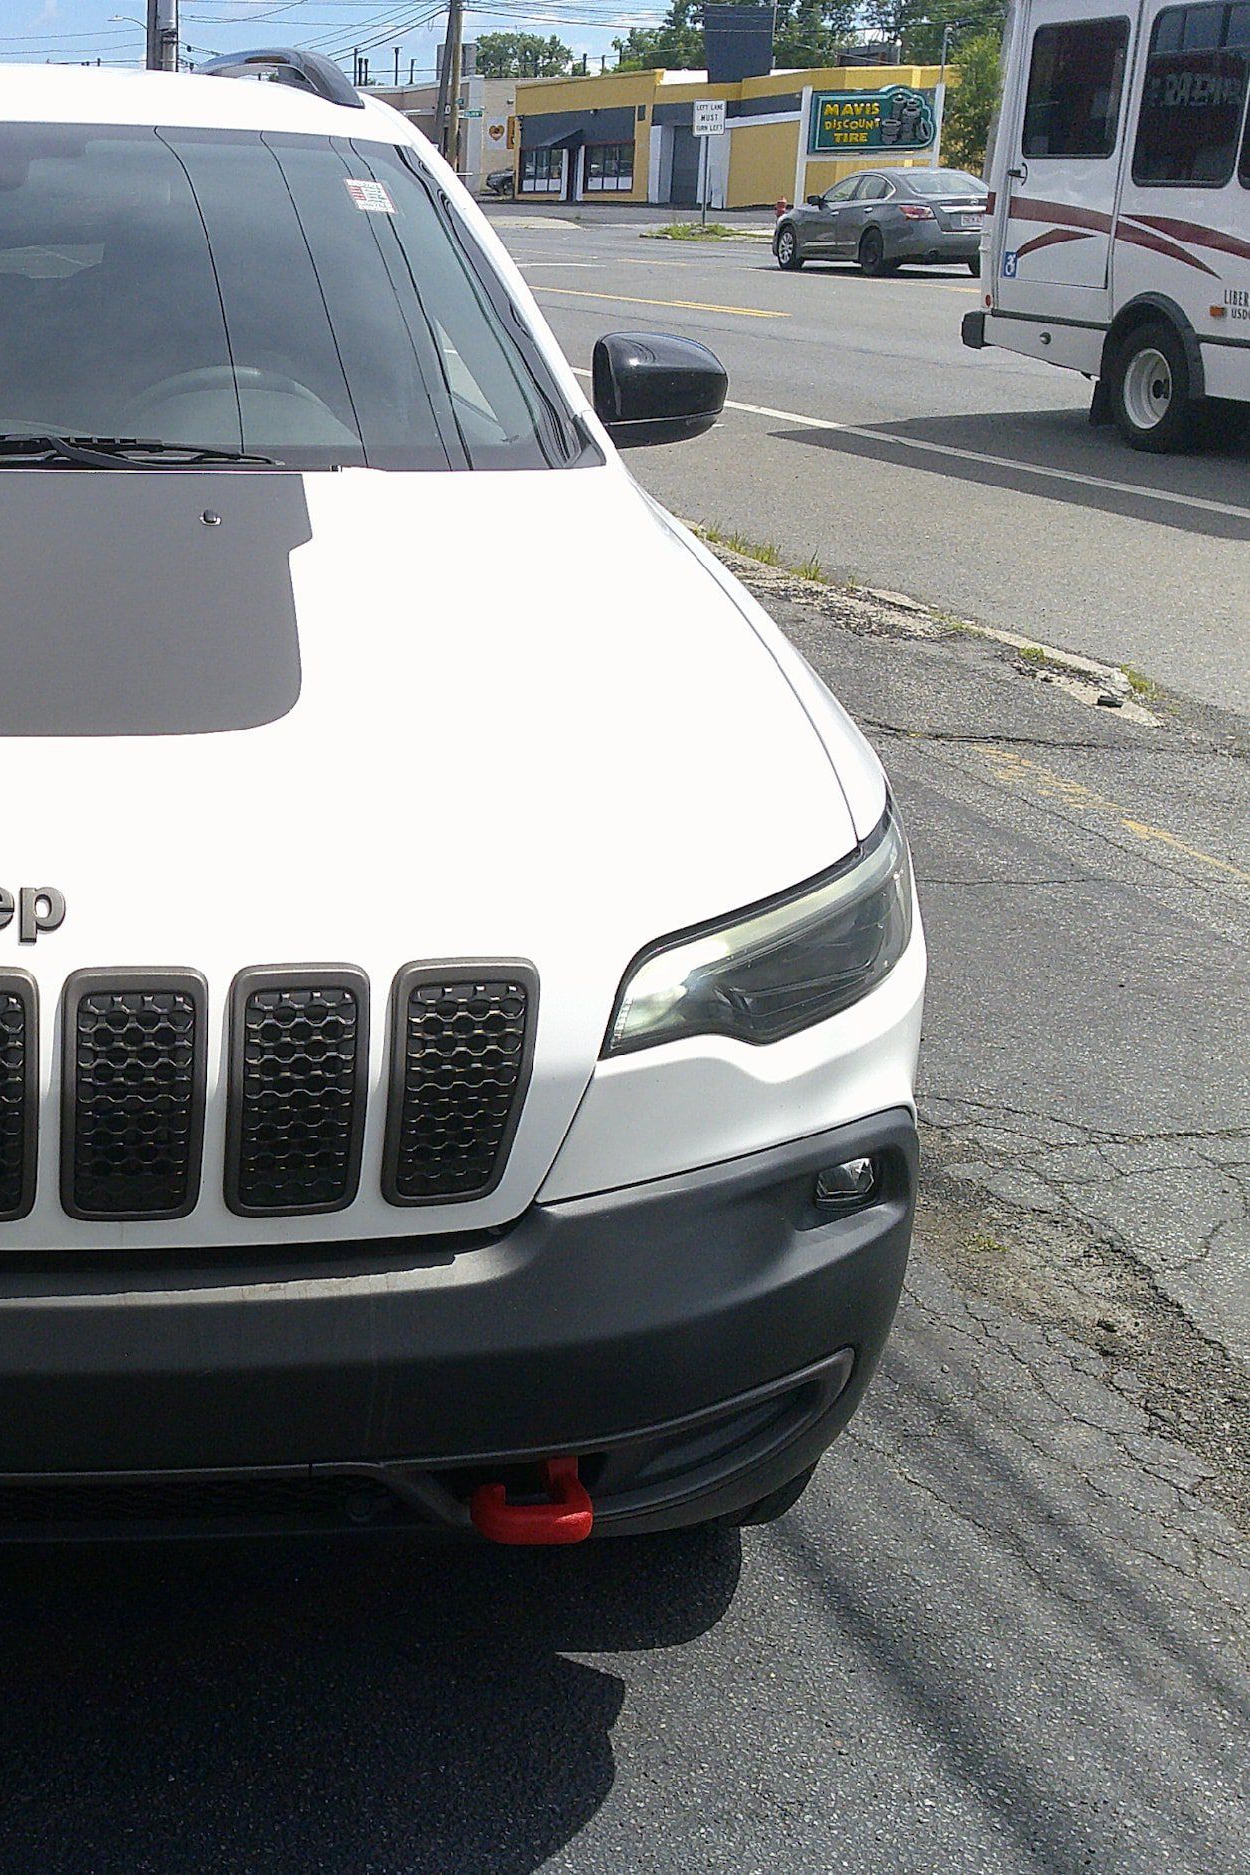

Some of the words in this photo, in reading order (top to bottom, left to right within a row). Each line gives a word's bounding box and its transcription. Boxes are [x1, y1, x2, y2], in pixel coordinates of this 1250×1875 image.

[824, 103, 880, 116] MAVIS
[701, 113, 718, 121] MUST
[824, 117, 881, 131] DISCOUNT
[834, 133, 869, 144] TIRE
[1231, 308, 1250, 321] USD
